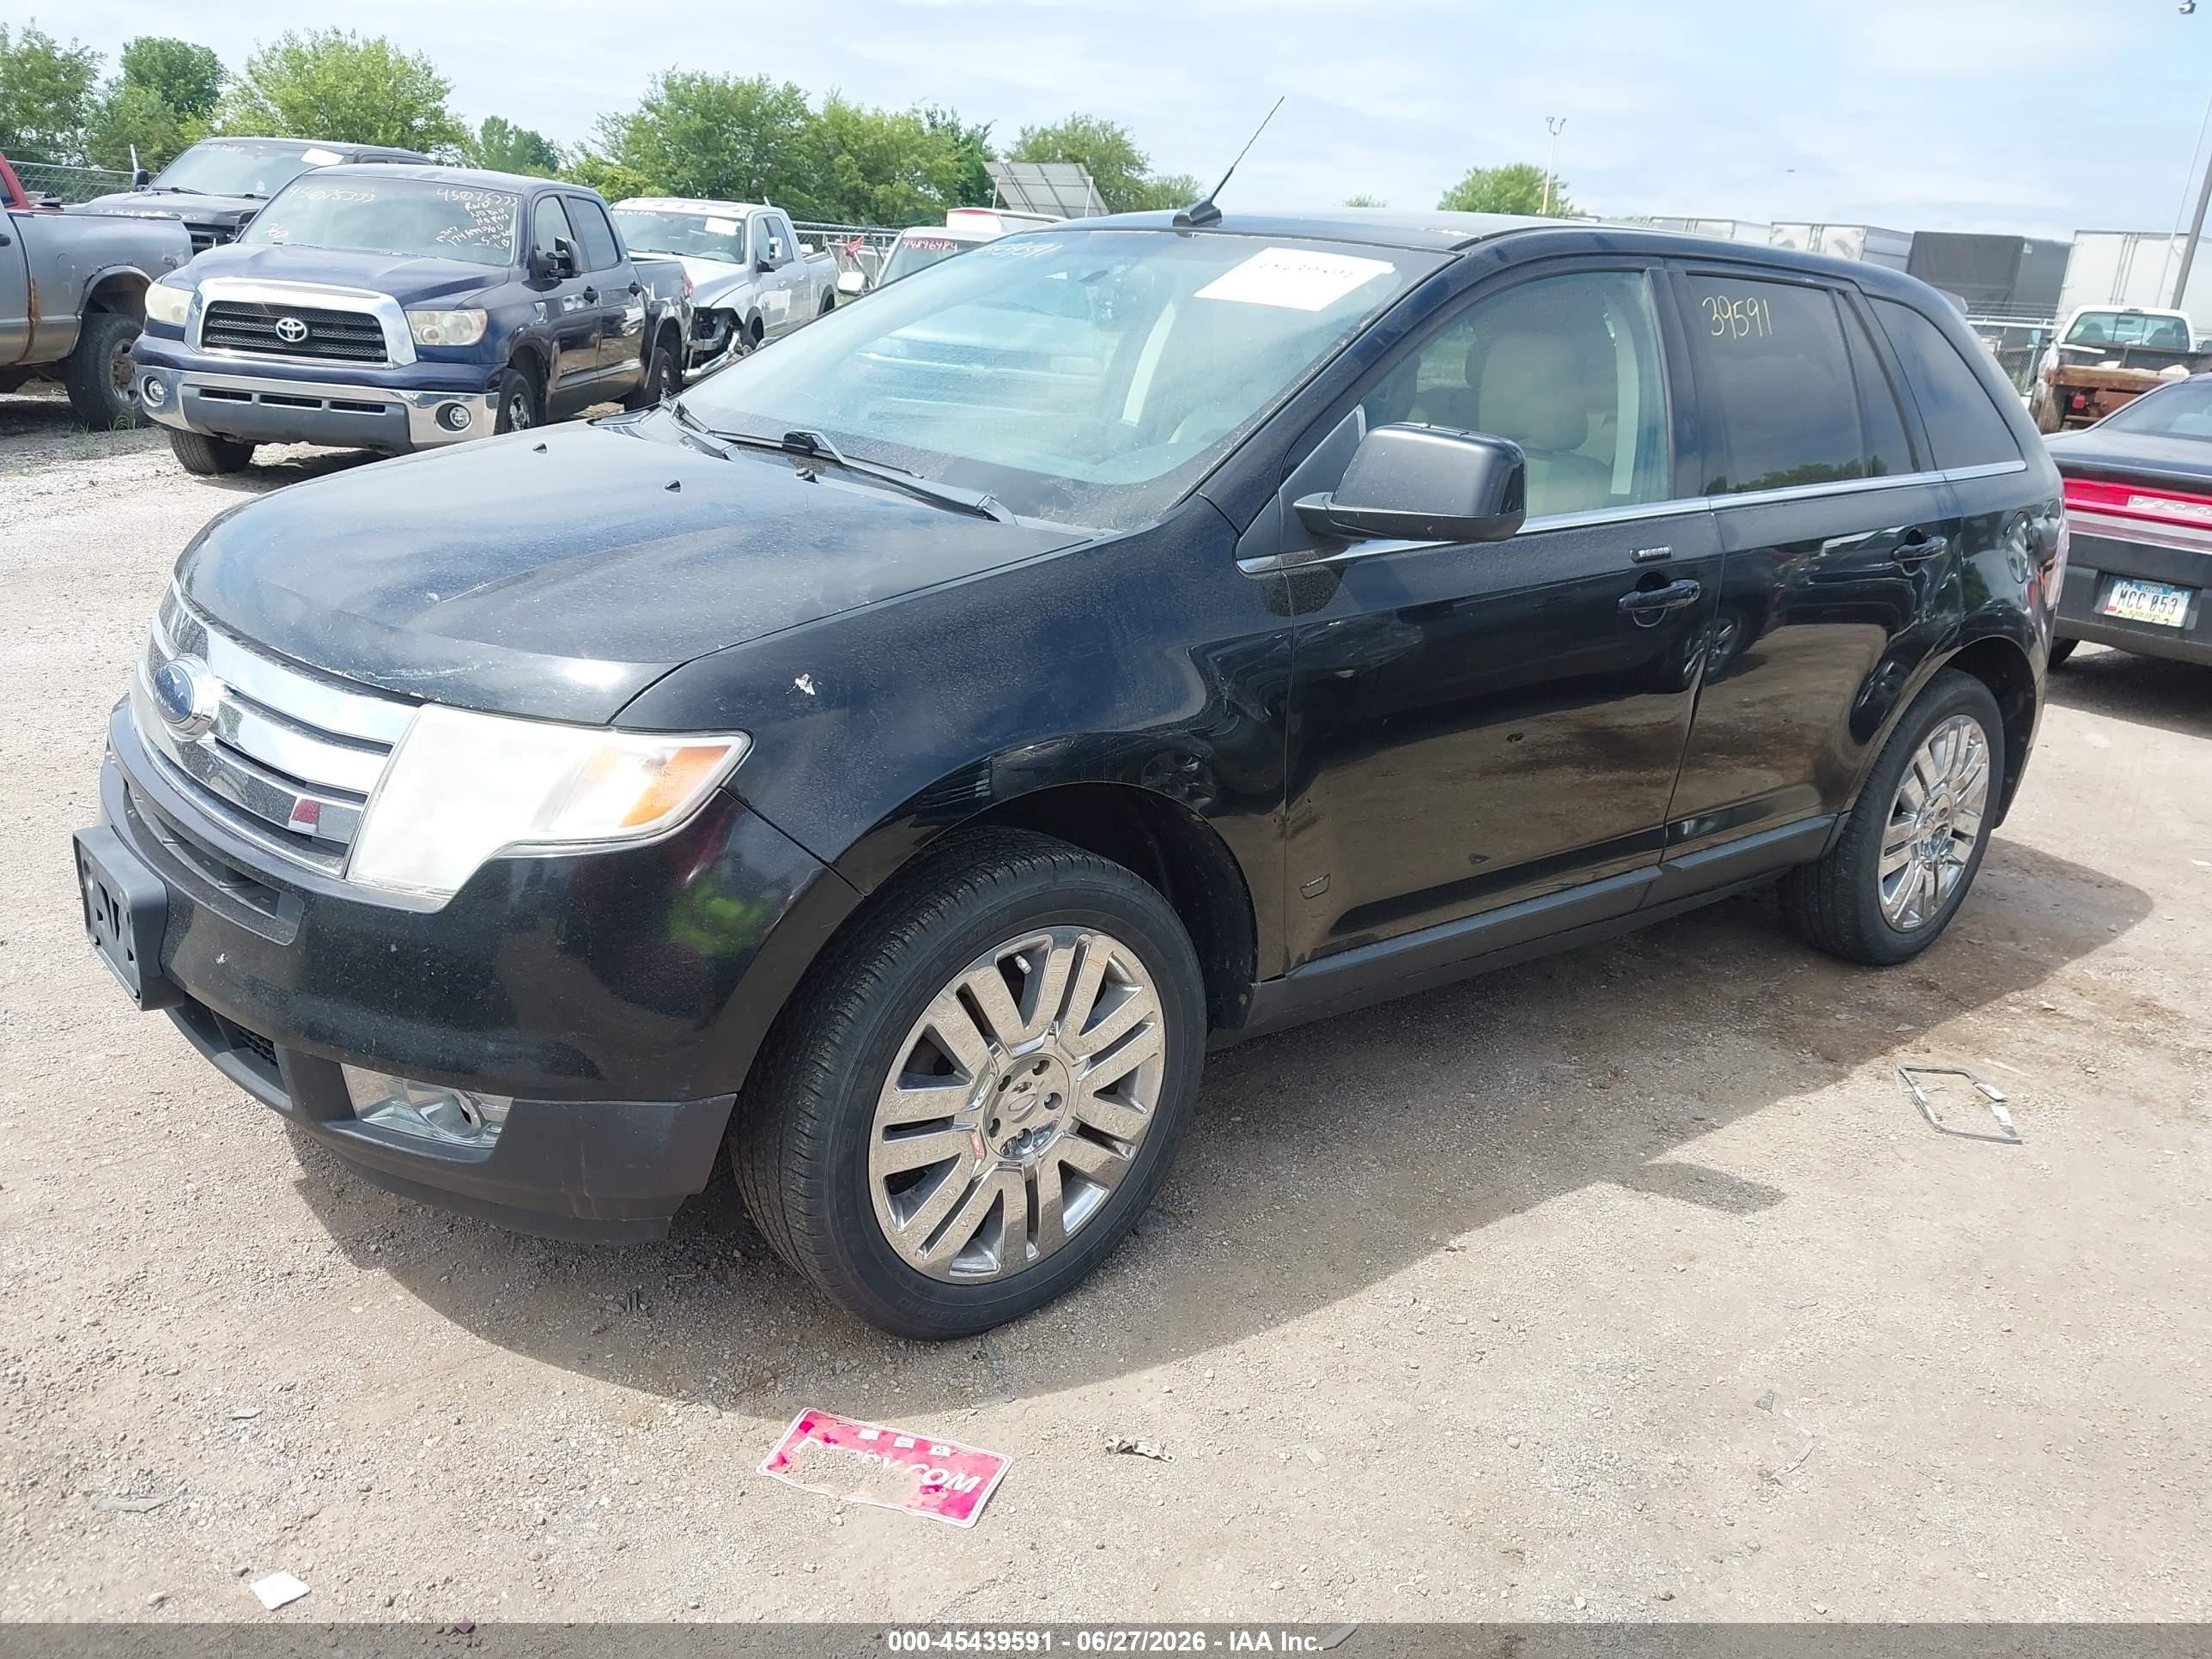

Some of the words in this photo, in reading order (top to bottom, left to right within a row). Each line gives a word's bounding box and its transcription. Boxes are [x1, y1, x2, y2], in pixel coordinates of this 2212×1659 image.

[436, 188, 519, 207] 45075333
[1702, 295, 1773, 340] 39591
[2141, 584, 2164, 594] IOWA
[2117, 589, 2146, 610] MCC
[2149, 594, 2179, 616] 053
